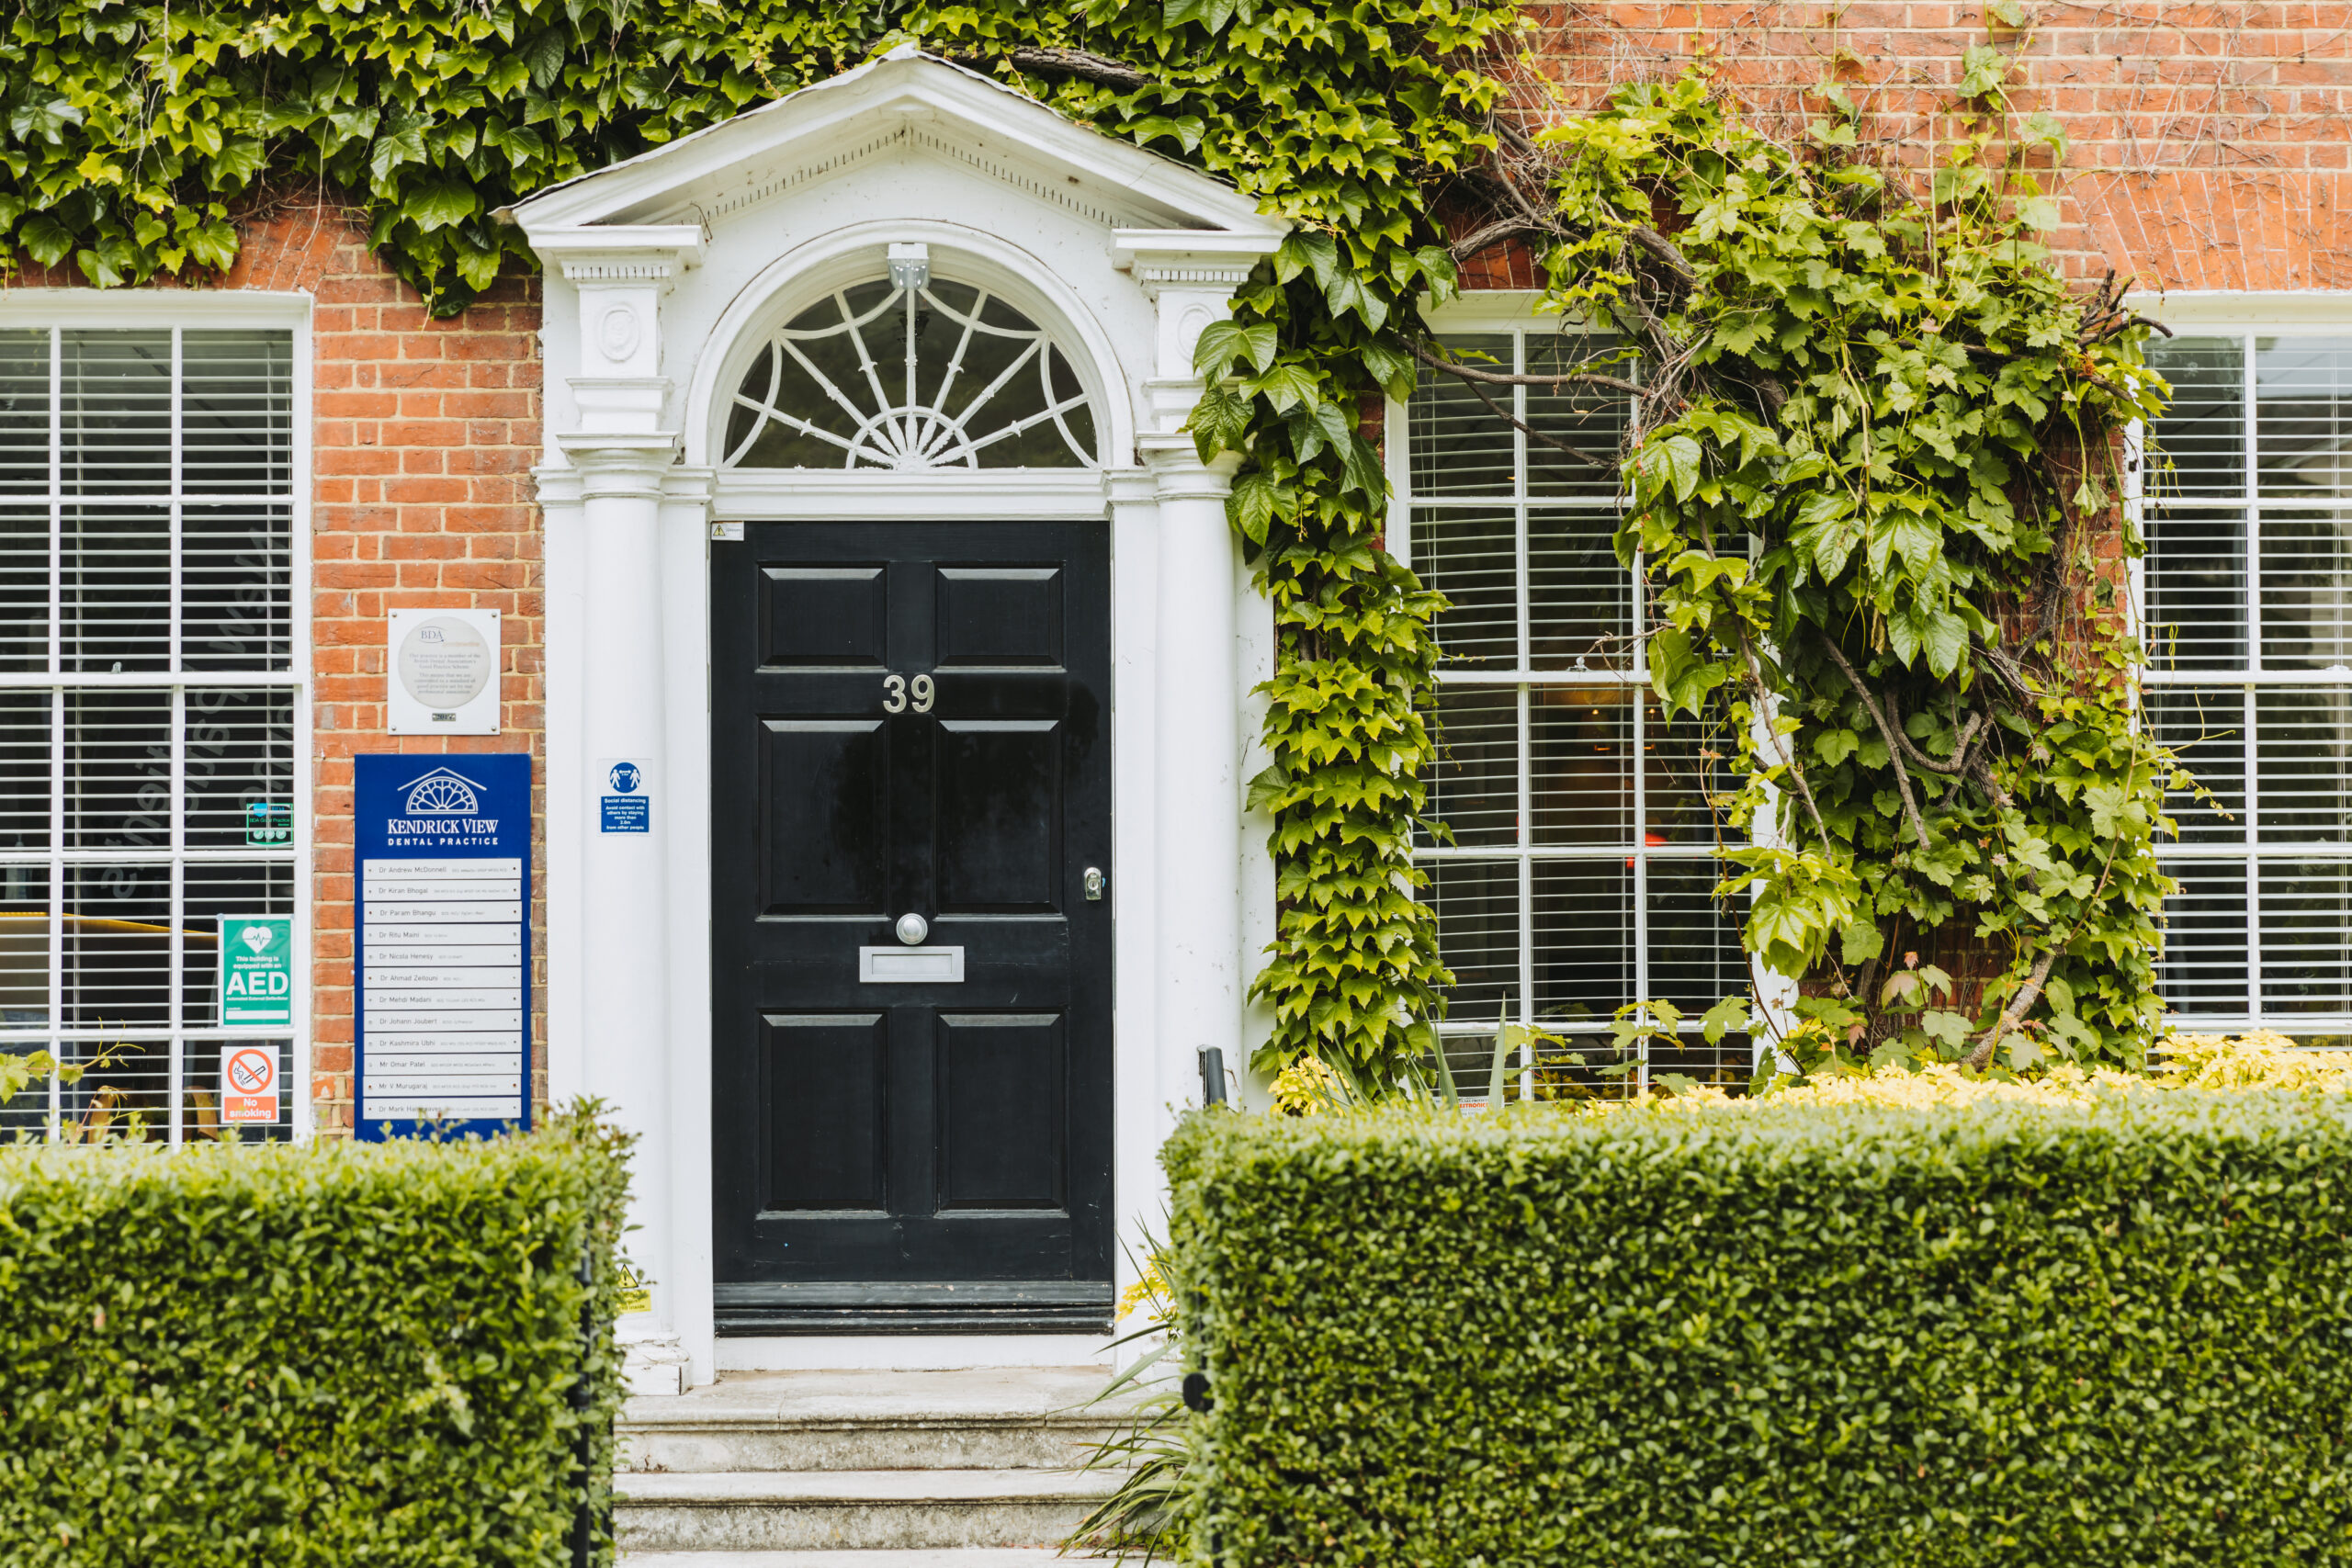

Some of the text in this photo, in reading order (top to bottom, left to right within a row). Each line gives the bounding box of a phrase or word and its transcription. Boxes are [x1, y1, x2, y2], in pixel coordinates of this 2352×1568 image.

[421, 630, 443, 640] BDA
[883, 674, 934, 713] 39
[388, 818, 499, 834] KENDRICK VIEW
[388, 838, 434, 846] DENTAL
[226, 972, 288, 995] AED
[243, 1098, 257, 1107] No
[229, 1108, 272, 1119] smoking
